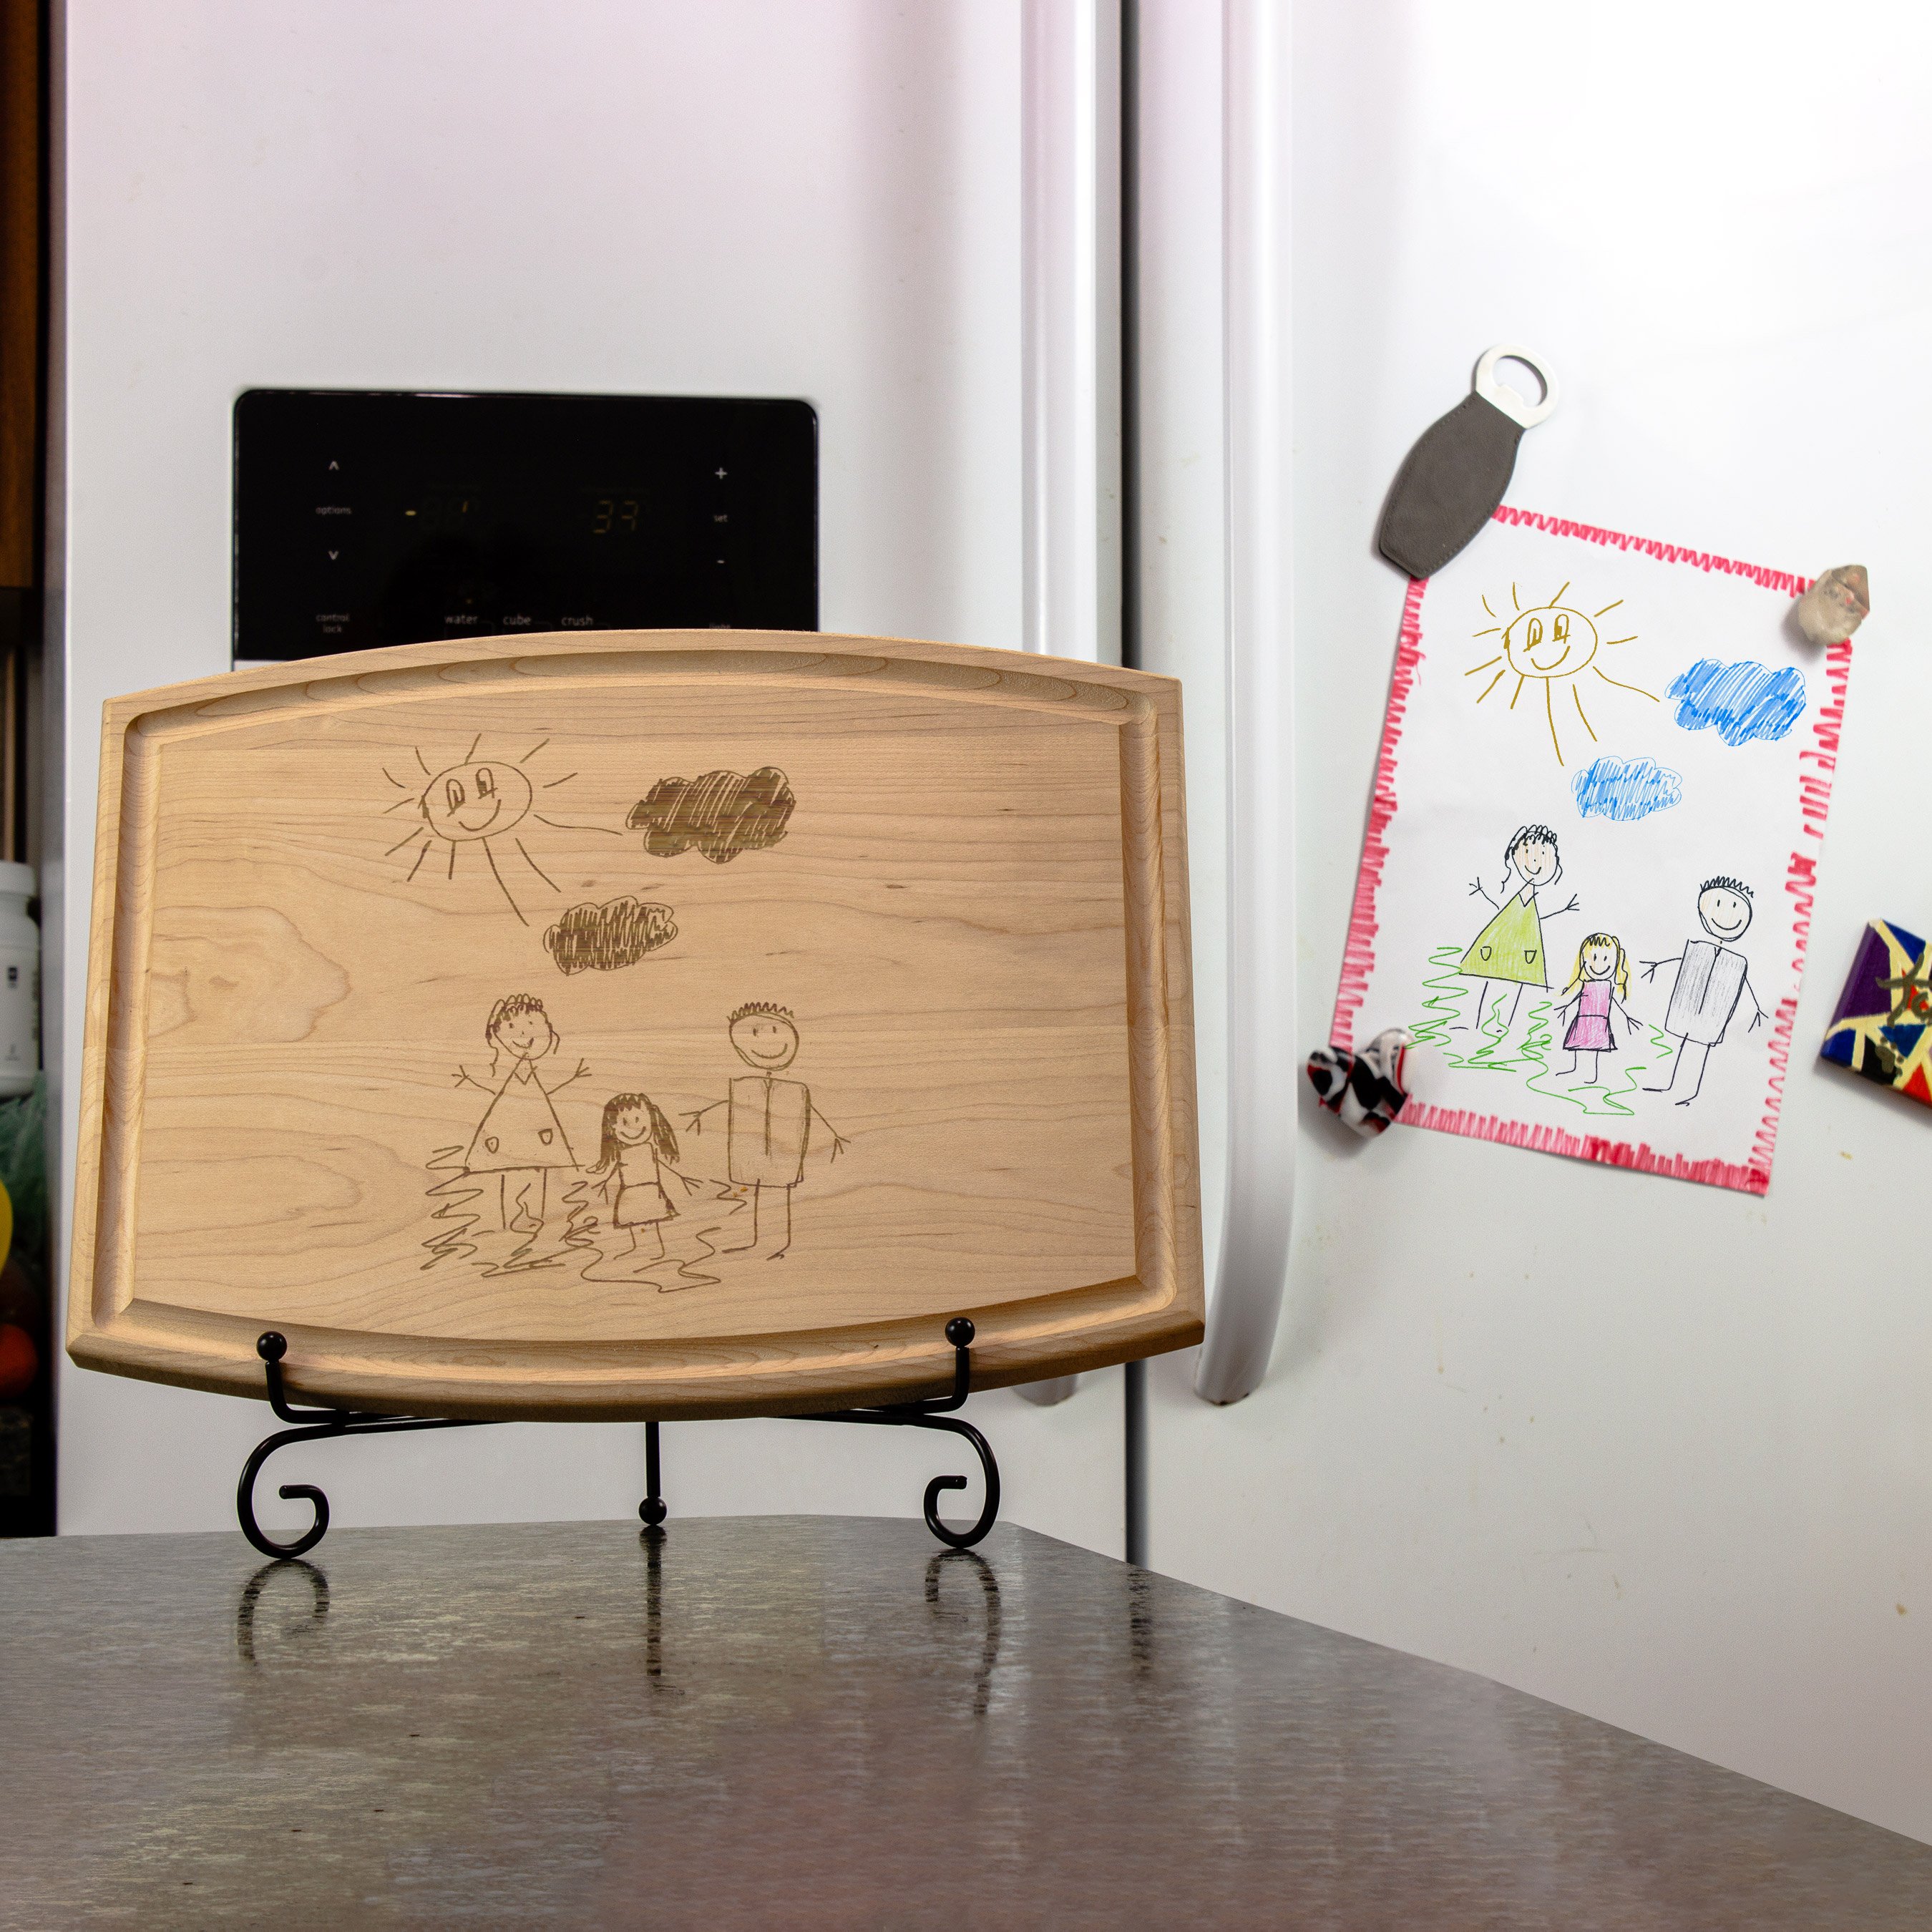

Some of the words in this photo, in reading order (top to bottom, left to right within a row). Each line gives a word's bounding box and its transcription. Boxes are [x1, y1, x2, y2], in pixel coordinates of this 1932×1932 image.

[315, 505, 353, 516] options
[713, 514, 728, 522] set
[316, 613, 351, 623] control
[444, 615, 478, 625] water
[502, 613, 532, 625] cube
[561, 615, 595, 626] crush
[323, 624, 343, 634] lock
